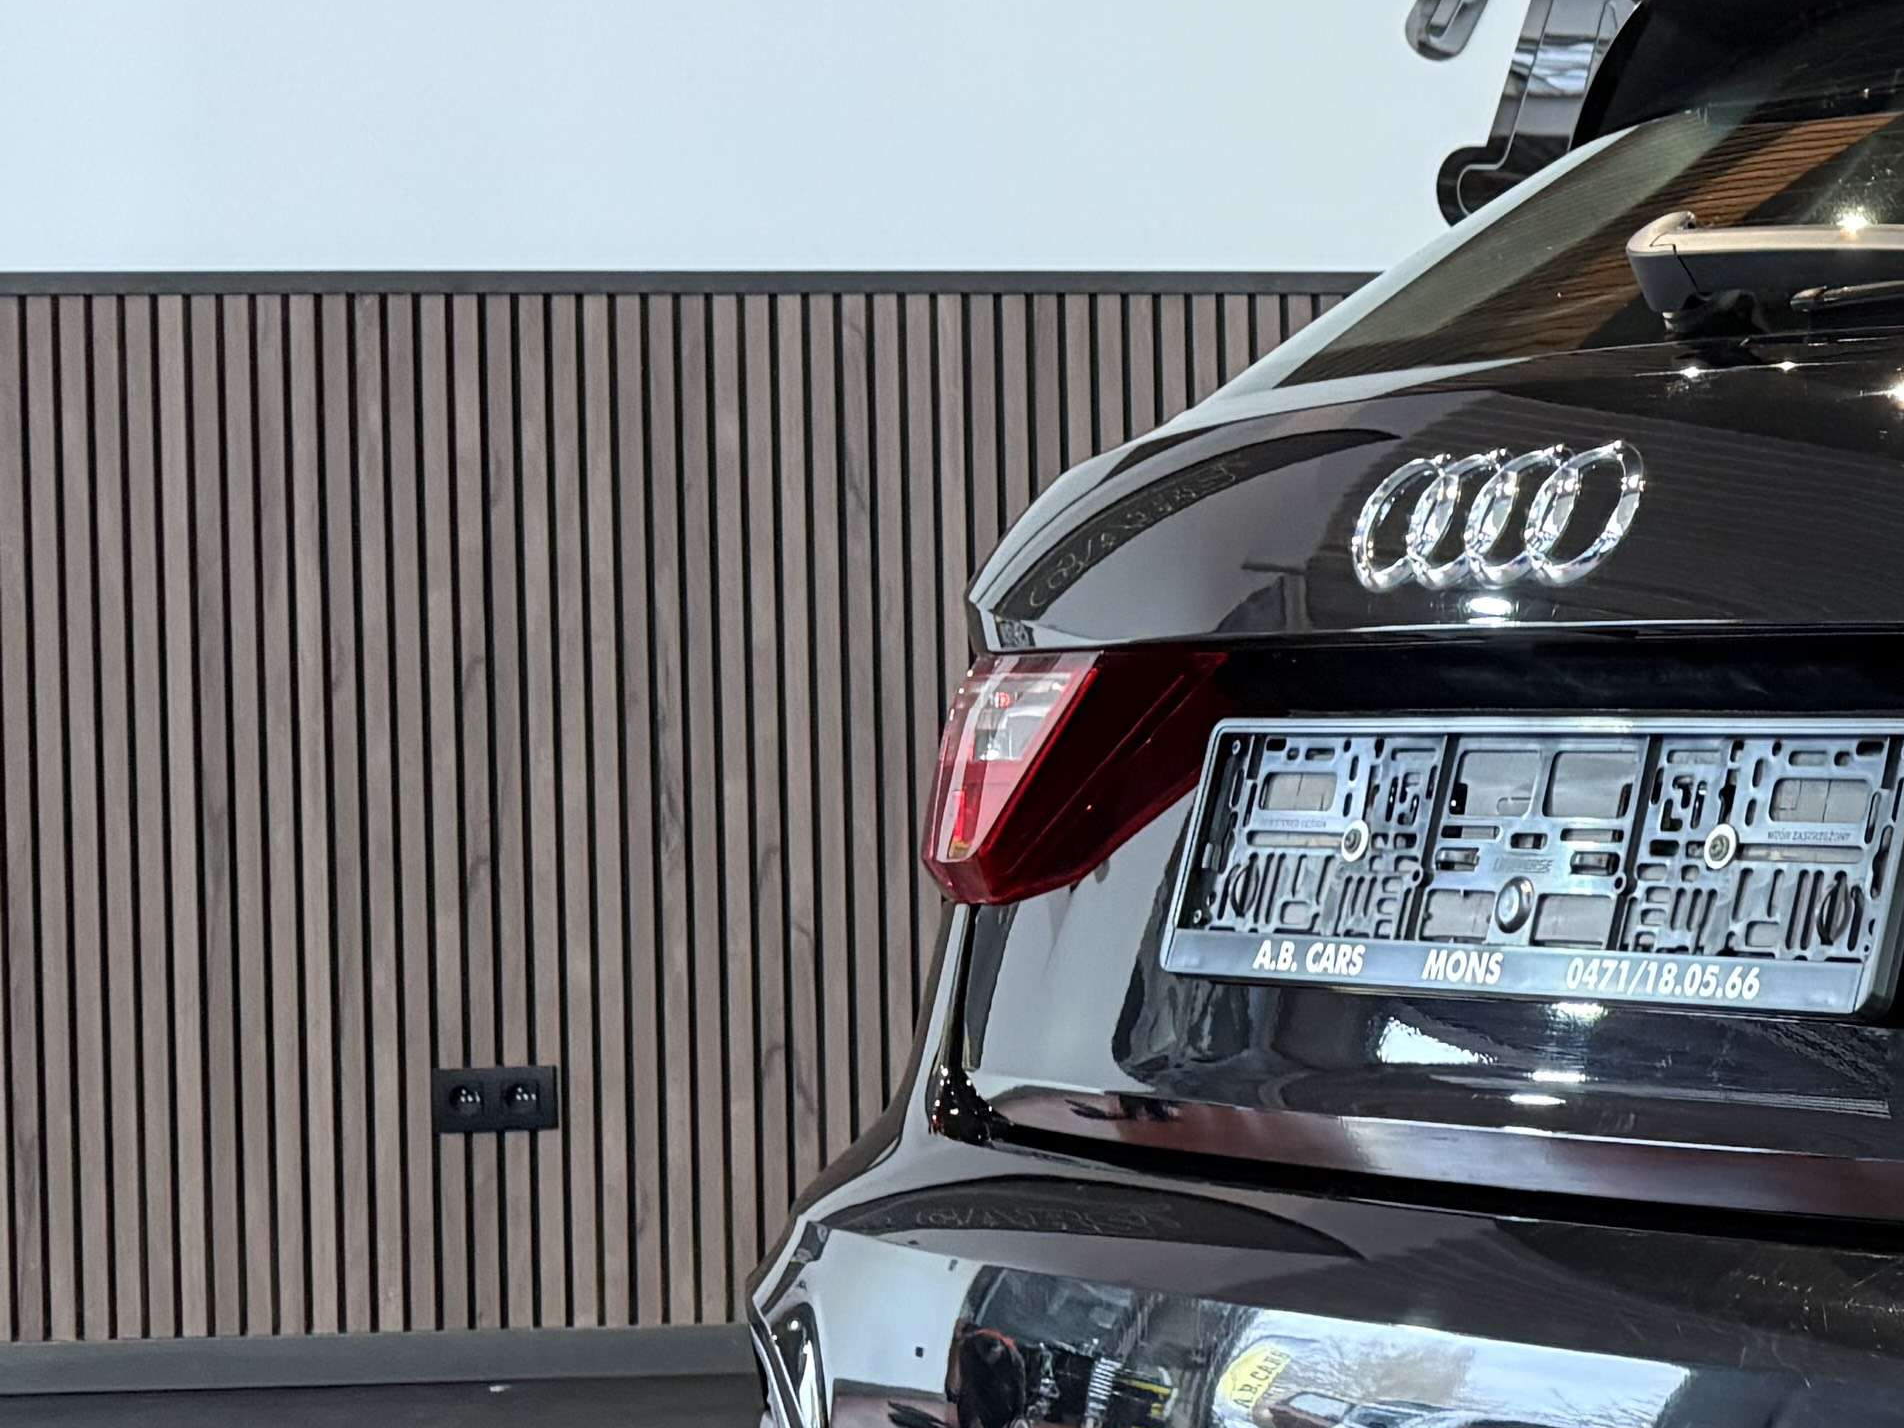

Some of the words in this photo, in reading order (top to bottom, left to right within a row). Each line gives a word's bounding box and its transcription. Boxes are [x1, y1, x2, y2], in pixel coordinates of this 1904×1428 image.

[1252, 939, 1298, 972] A.B.
[1305, 942, 1367, 976] CARS
[1421, 948, 1505, 984] MONS
[1566, 957, 1760, 1000] 0471/18.05.66
